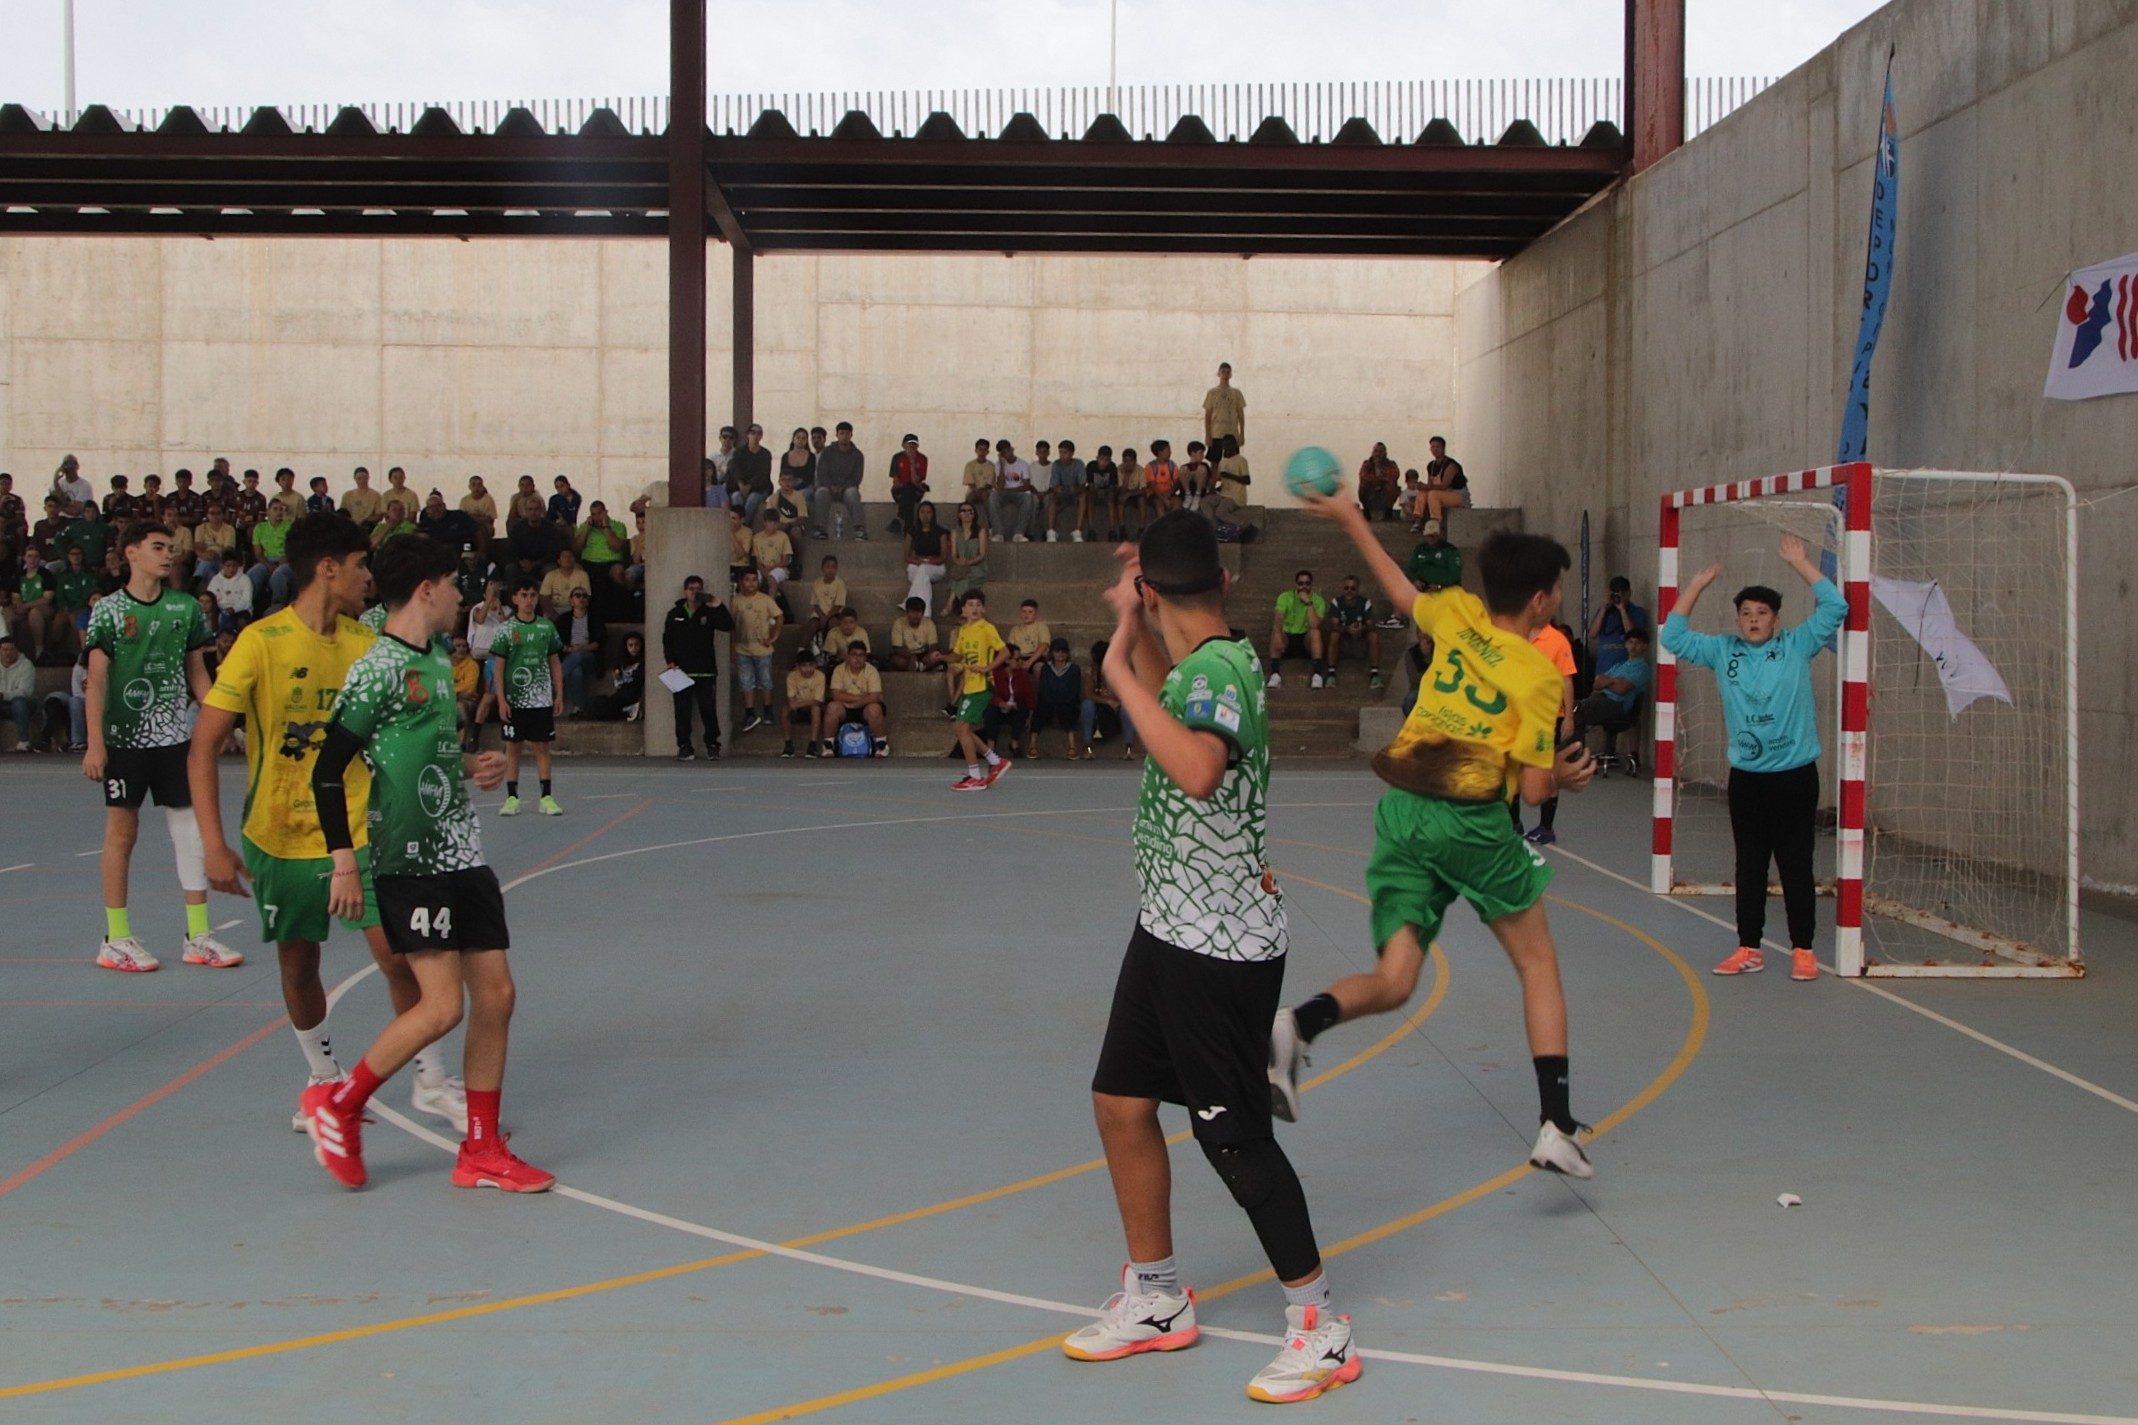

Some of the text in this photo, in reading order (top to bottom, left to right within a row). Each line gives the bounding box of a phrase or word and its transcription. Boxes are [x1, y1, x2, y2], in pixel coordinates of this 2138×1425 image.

[316, 688, 339, 711] 17
[503, 724, 515, 738] 14
[107, 778, 127, 799] 31
[1136, 832, 1173, 859] vending
[263, 903, 280, 929] 7
[409, 906, 452, 939] 44
